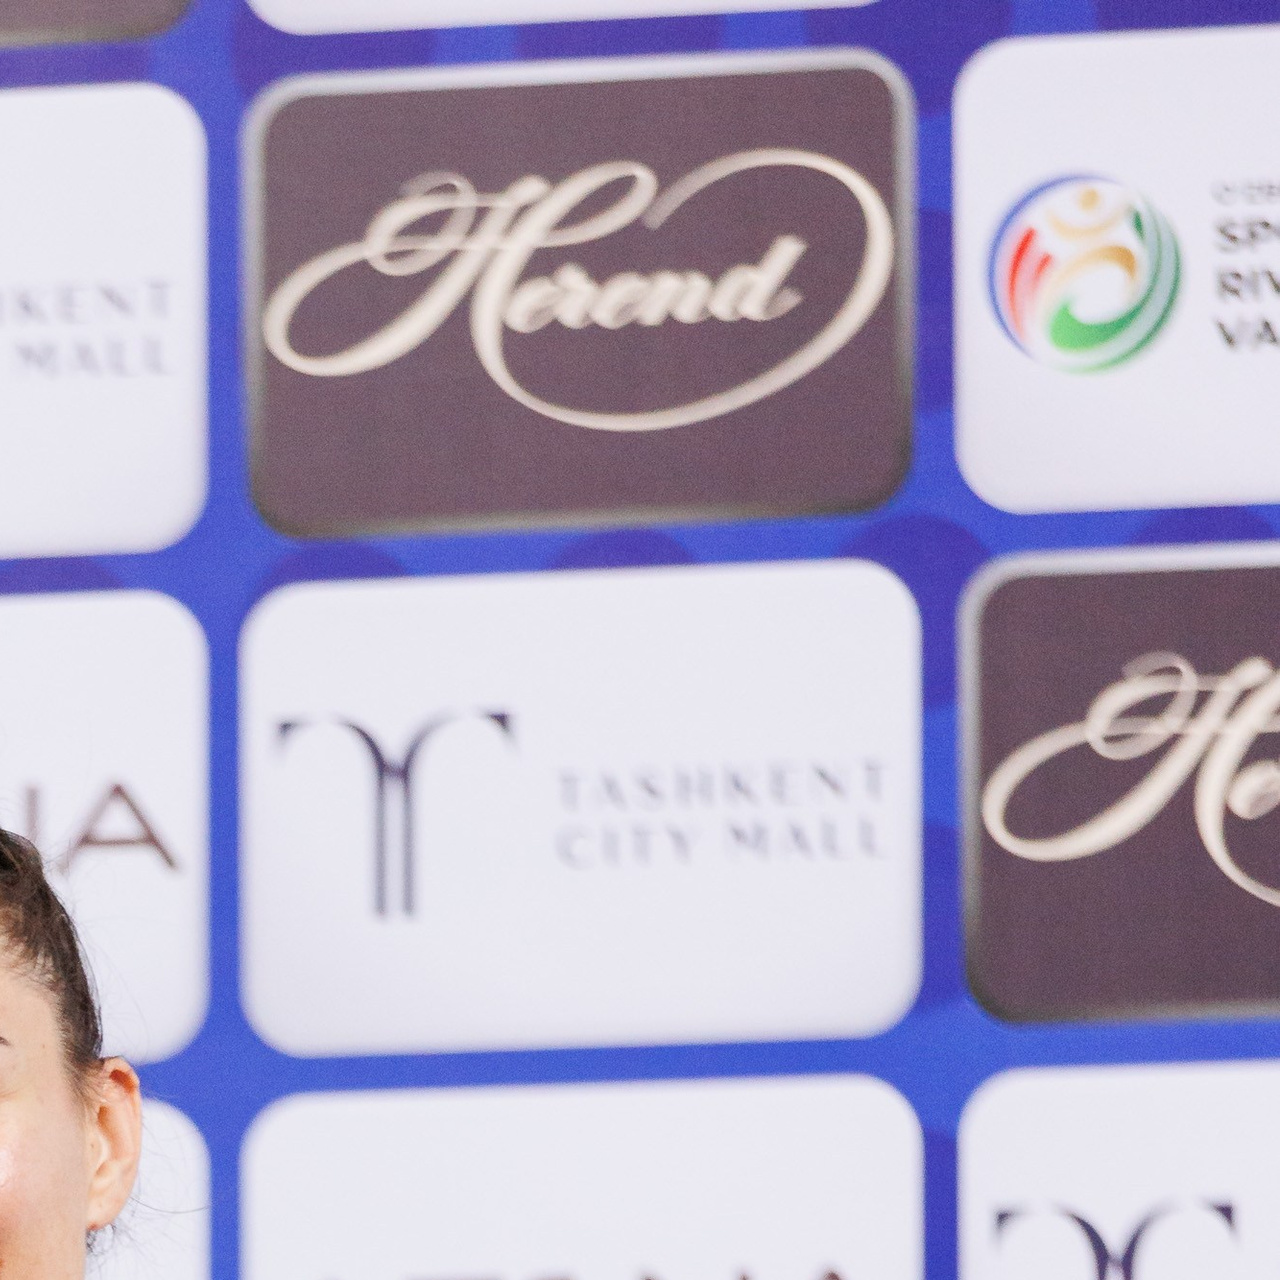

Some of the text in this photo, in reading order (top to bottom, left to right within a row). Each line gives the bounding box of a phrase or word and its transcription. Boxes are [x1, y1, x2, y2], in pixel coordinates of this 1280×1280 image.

[263, 148, 894, 432] Herend
[18, 335, 176, 380] MALL
[556, 760, 890, 814] TASHKENT
[554, 818, 888, 869] CITY MALL
